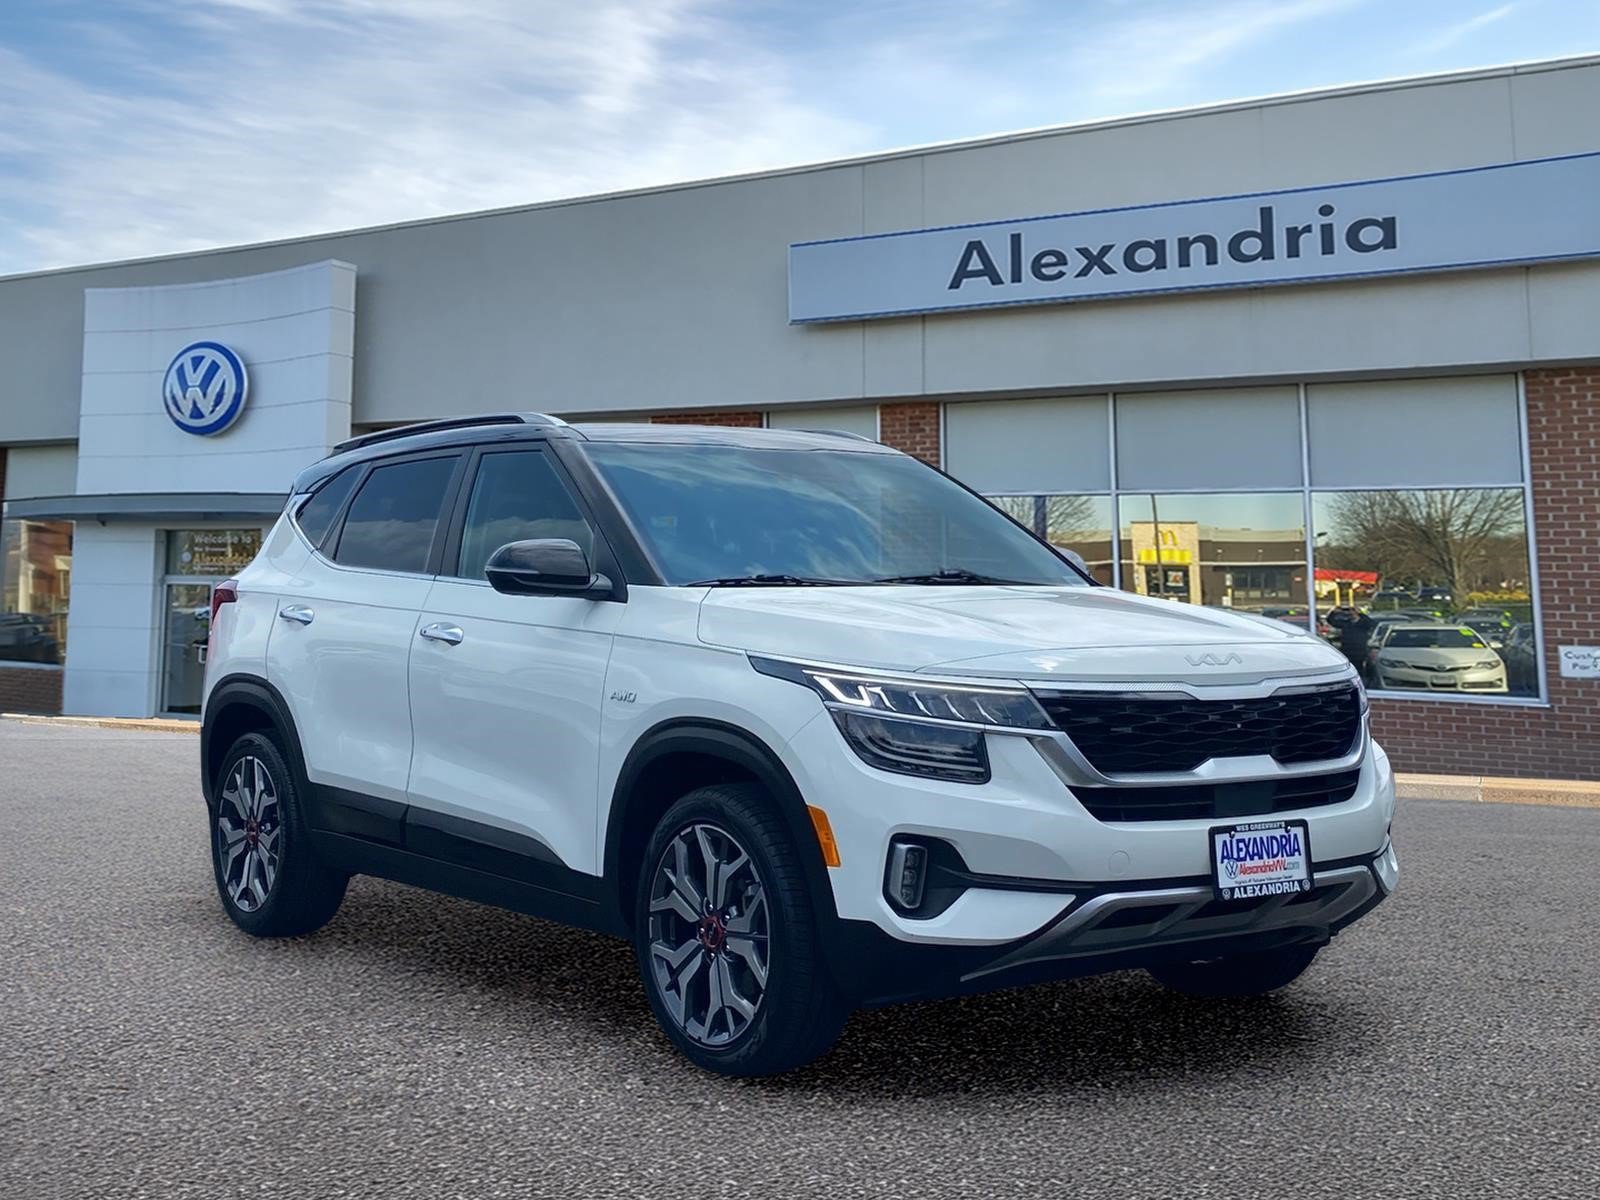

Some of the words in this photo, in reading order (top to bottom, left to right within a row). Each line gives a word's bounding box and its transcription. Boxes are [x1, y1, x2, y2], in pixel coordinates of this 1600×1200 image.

[948, 204, 1398, 290] Alexandria
[194, 535, 240, 543] Welcome
[1221, 833, 1302, 864] ALEXANDRIA
[1233, 880, 1301, 899] ALEXANDRIA
